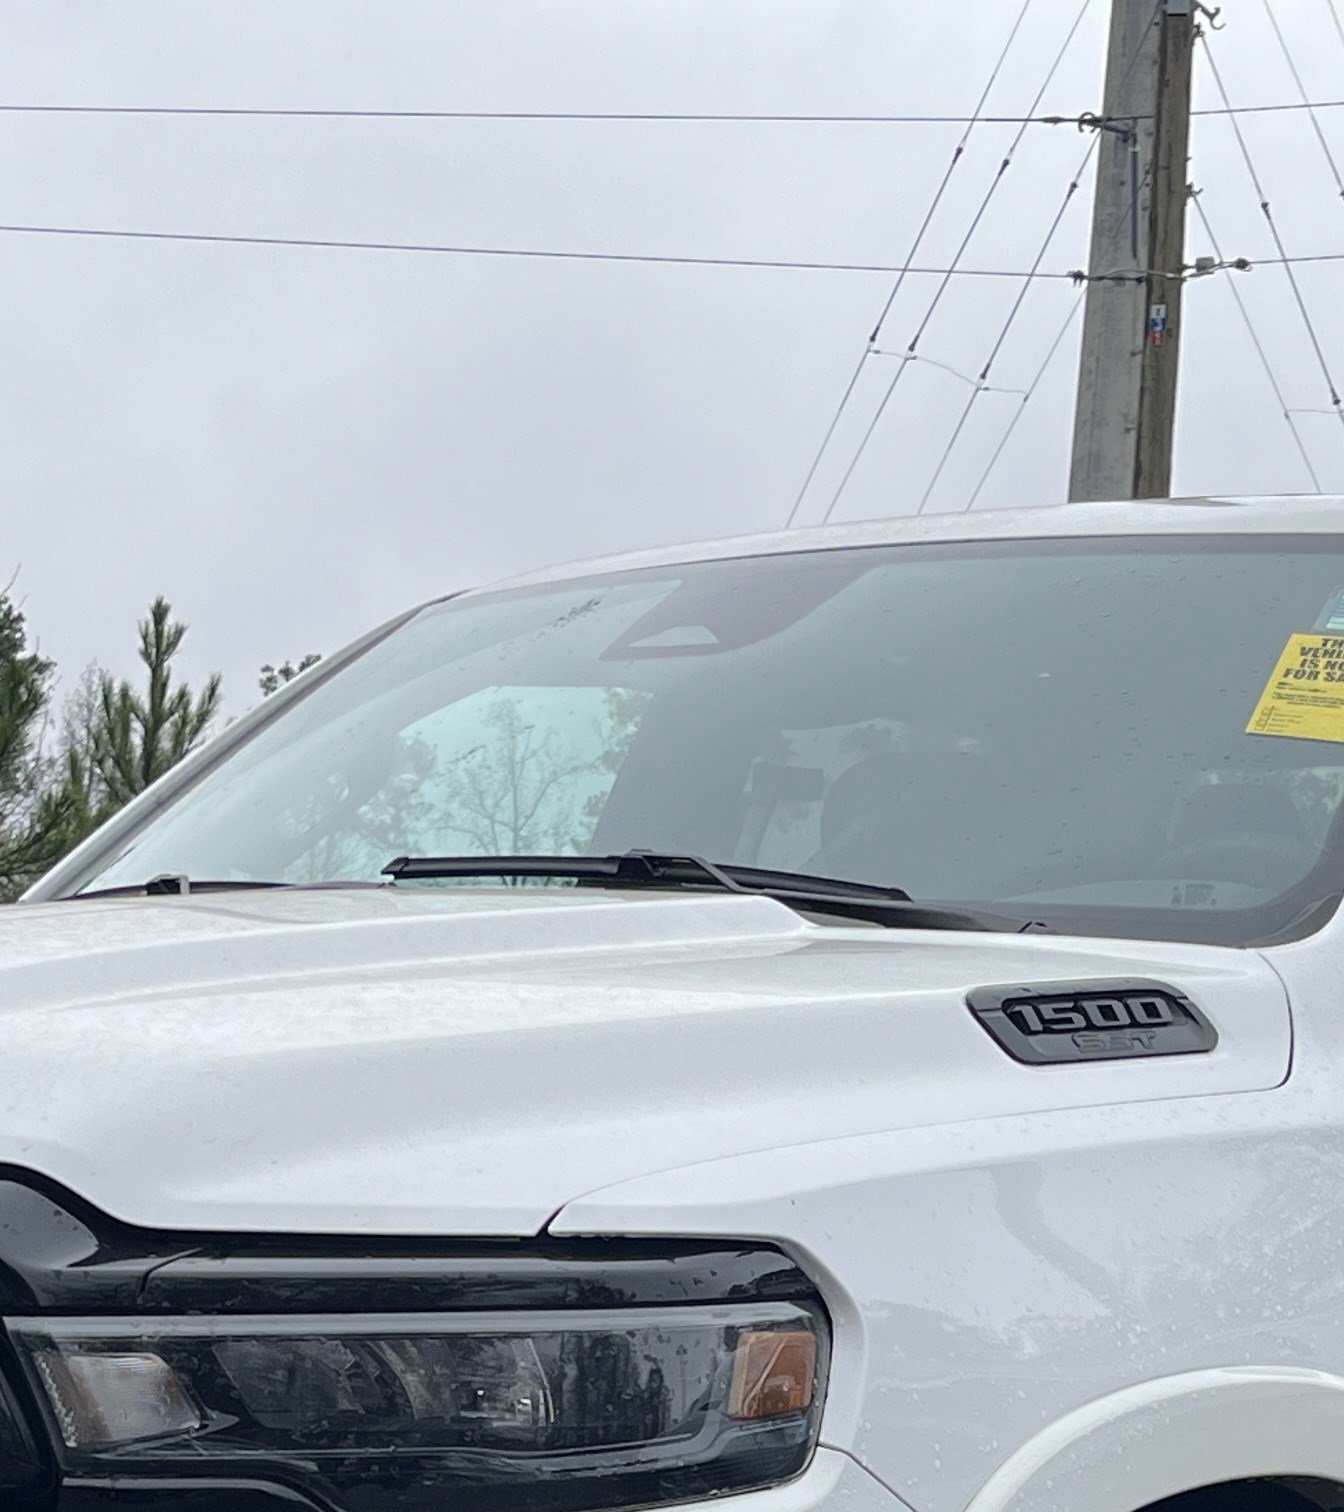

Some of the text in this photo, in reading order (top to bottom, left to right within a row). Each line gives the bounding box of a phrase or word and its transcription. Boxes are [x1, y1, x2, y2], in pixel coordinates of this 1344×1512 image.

[1300, 658, 1320, 669] IS
[1282, 667, 1321, 681] FOR
[1007, 997, 1174, 1032] 1500
